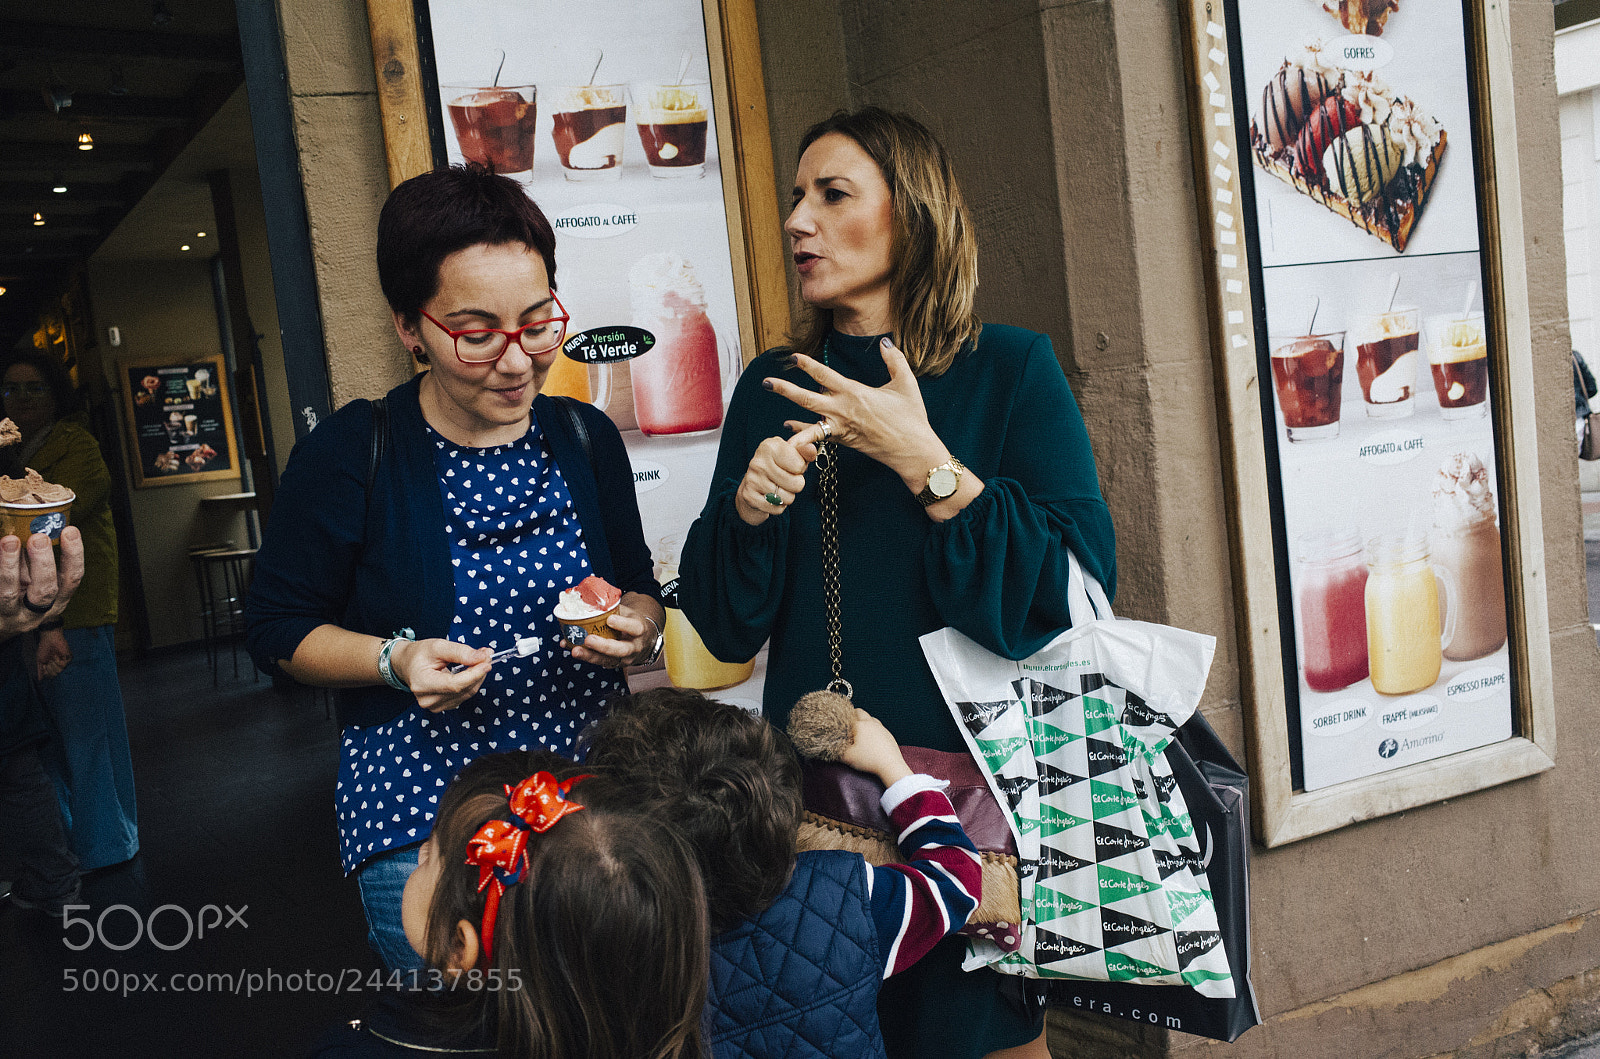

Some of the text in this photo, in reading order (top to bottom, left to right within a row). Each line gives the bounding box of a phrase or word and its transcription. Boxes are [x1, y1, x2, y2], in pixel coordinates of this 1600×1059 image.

[1344, 47, 1375, 59] GOFRES
[555, 216, 600, 229] AFFOGATO
[564, 333, 588, 353] NUEVA
[591, 331, 626, 344] Versión
[581, 344, 597, 360] Té
[1359, 442, 1395, 458] AFFOGATO
[633, 469, 661, 483] DRINK
[1447, 680, 1480, 697] ESPRESSO
[1085, 710, 1093, 719] El
[1312, 707, 1367, 729] SORBET DRINK
[1401, 732, 1444, 752] Amorino
[1089, 752, 1097, 761] El
[1097, 752, 1114, 762] Corte
[1092, 794, 1101, 803] El
[1101, 793, 1119, 803] Corte
[1095, 836, 1104, 846] El
[1104, 836, 1123, 846] Corte
[1100, 877, 1150, 892] El Corte Inglés
[1042, 898, 1059, 908] Corte
[1103, 920, 1157, 935] El Corte Inglés
[1041, 942, 1060, 952] Corte
[1059, 940, 1086, 956] Inglés
[1177, 933, 1220, 954] El Corte Inglés
[1107, 964, 1117, 973] El
[1116, 962, 1136, 973] Corte
